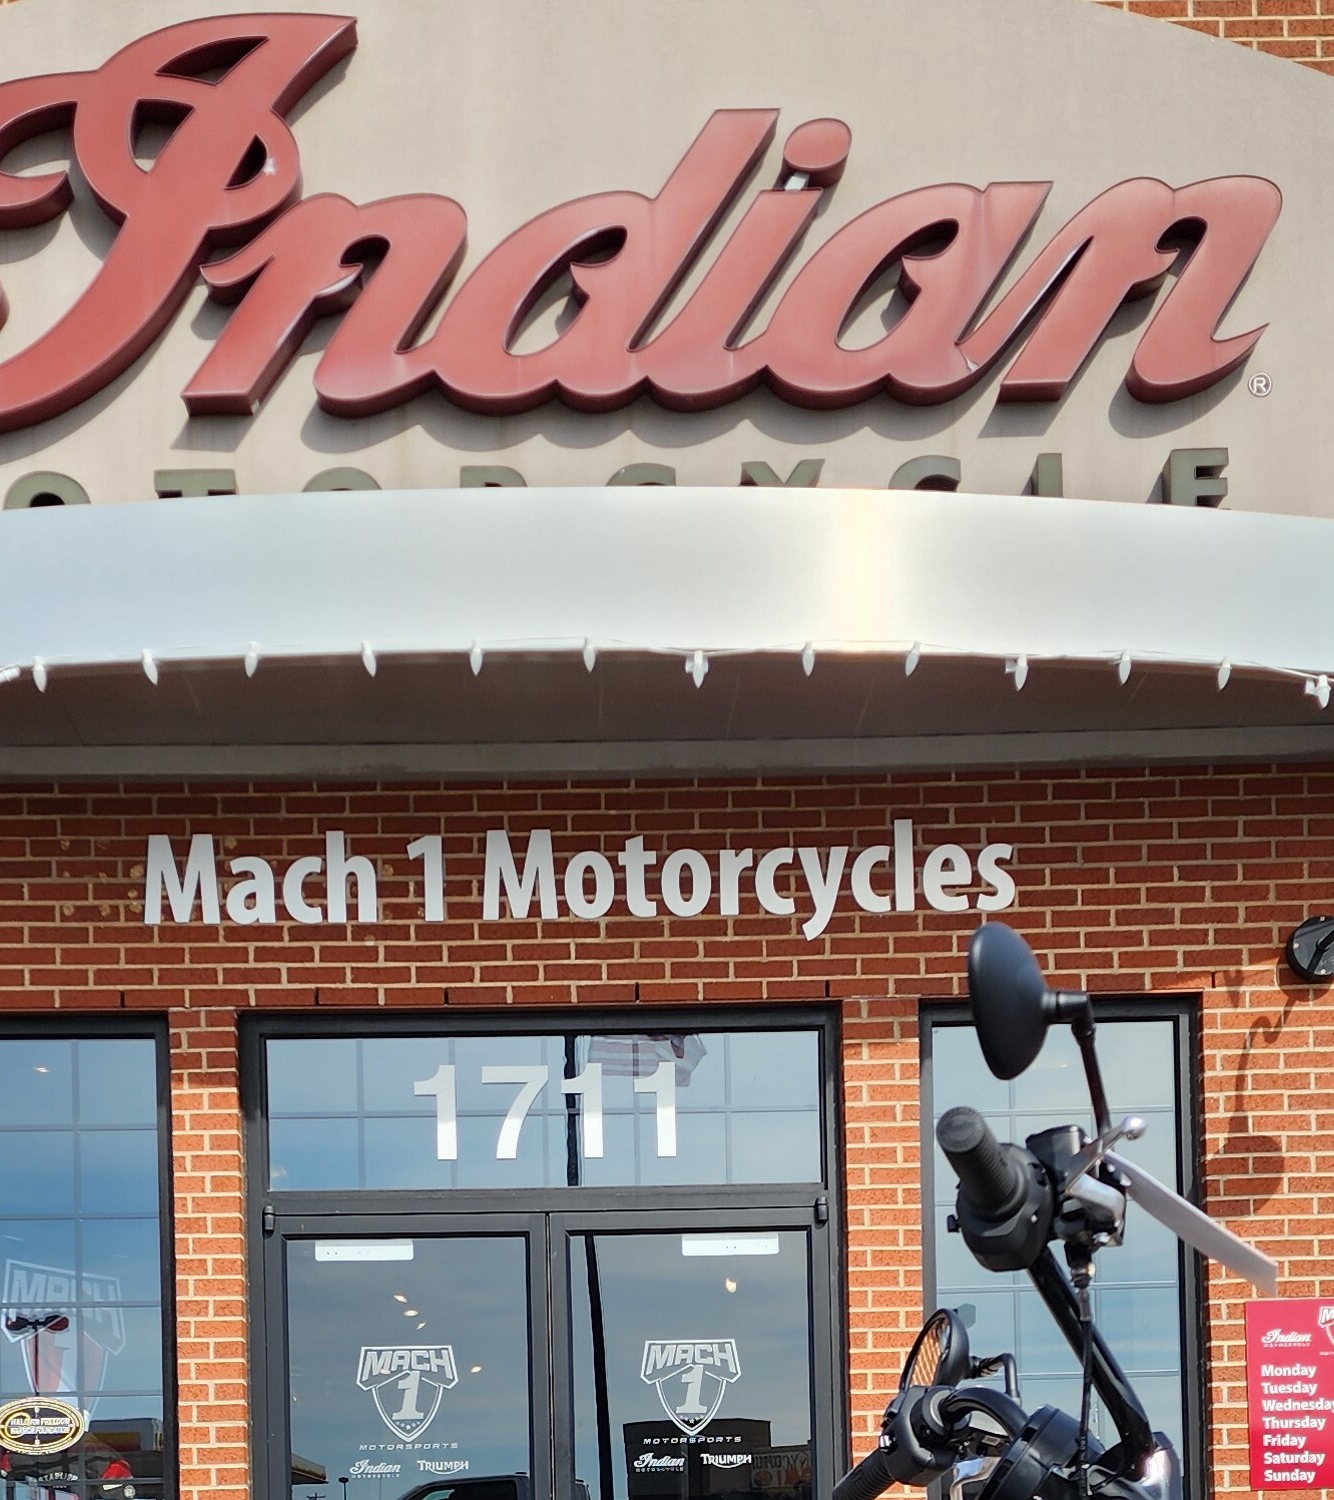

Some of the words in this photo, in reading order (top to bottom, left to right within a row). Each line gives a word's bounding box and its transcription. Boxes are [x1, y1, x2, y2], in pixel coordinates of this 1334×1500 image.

[143, 830, 379, 925] Mach
[406, 835, 444, 922] 1
[482, 818, 1016, 941] Motorcycles
[413, 1061, 677, 1161] 1711
[1261, 1328, 1312, 1344] Indian
[362, 1349, 454, 1382] MACH
[646, 1343, 737, 1376] MACH
[1261, 1363, 1317, 1379] Monday
[392, 1370, 424, 1421] 1
[676, 1364, 708, 1414] 1
[1261, 1381, 1318, 1396] Tuesday
[1262, 1416, 1326, 1431] Thursday
[359, 1442, 459, 1451] MOTORSPORTS
[642, 1435, 742, 1445] MOTORSPORTS
[1263, 1434, 1306, 1449] Friday
[633, 1452, 685, 1468] Indian
[700, 1453, 752, 1468] TRIUMPH
[1264, 1451, 1325, 1466] Saturday
[349, 1459, 402, 1475] Indian
[416, 1460, 470, 1475] TRIUMPH
[1264, 1469, 1316, 1483] Sunday
